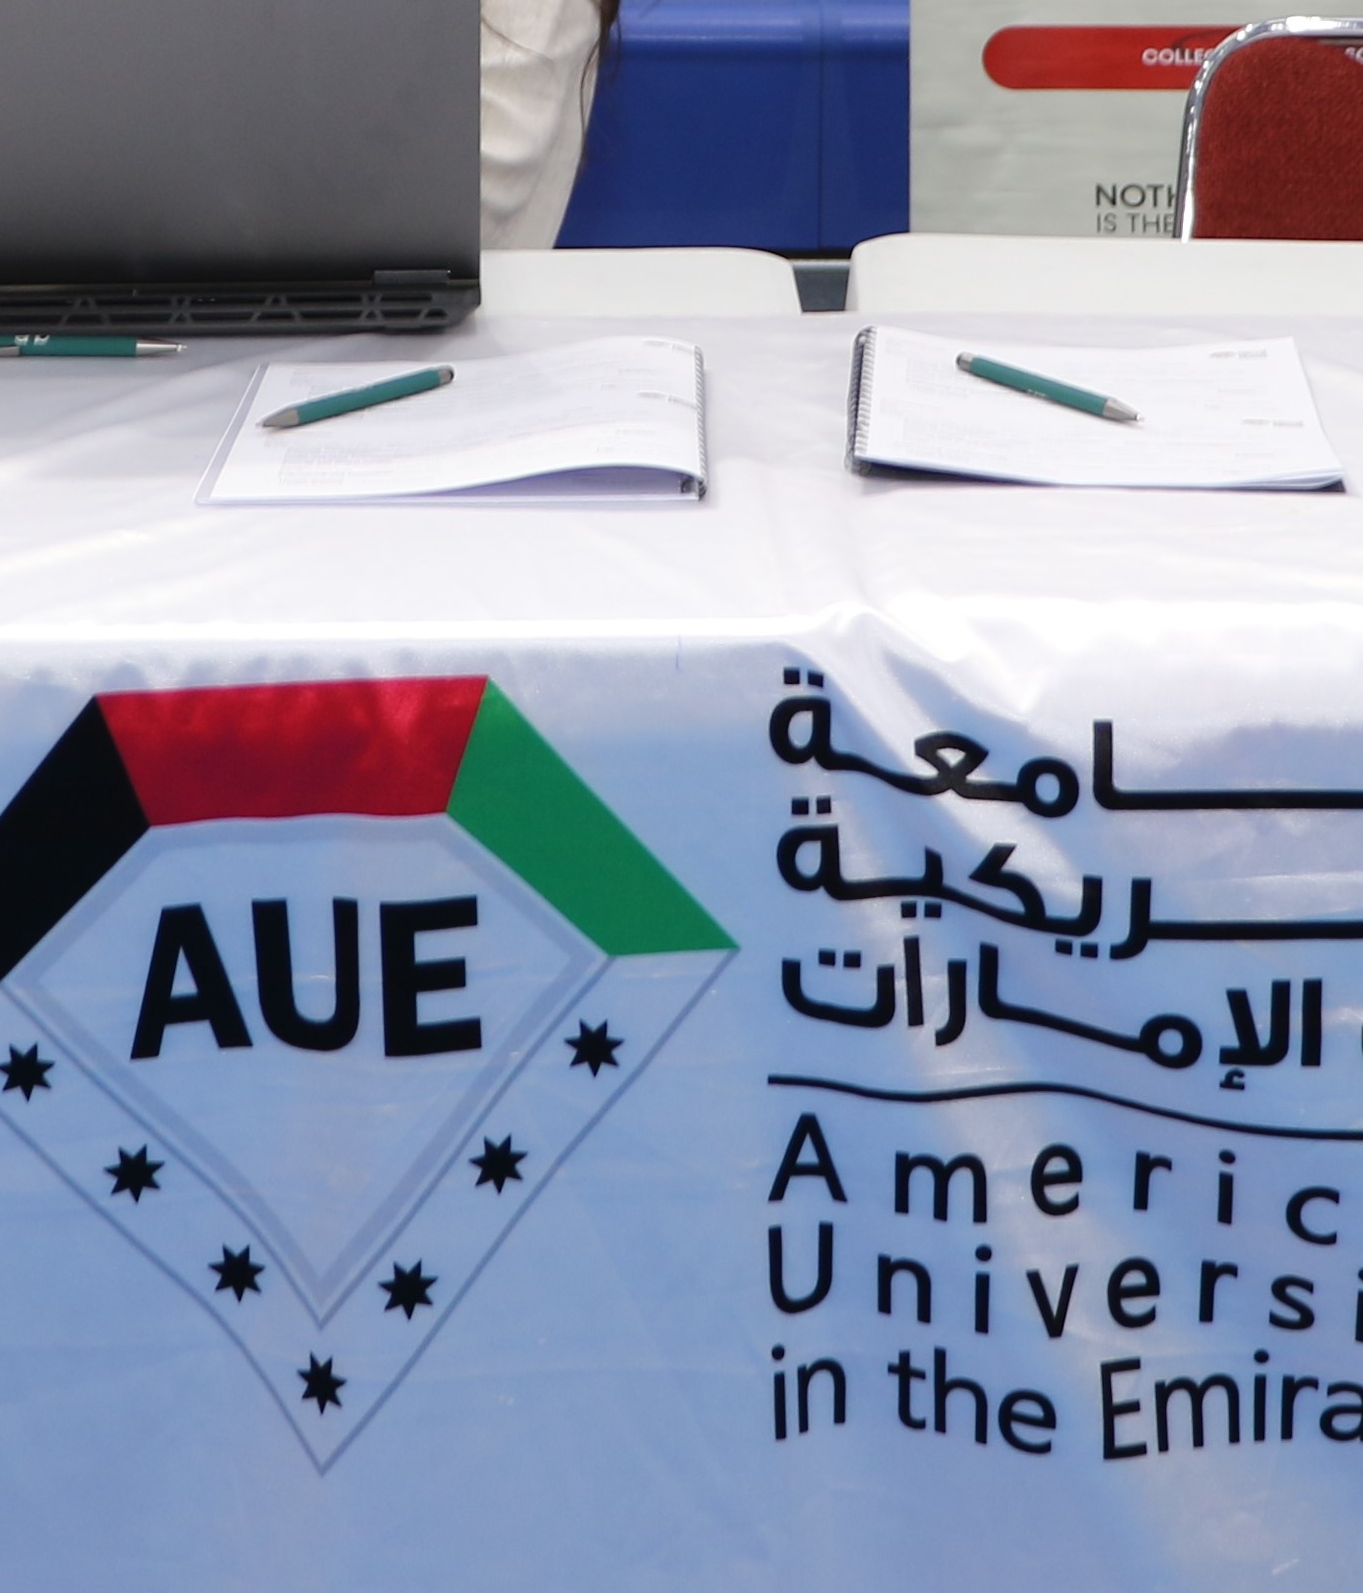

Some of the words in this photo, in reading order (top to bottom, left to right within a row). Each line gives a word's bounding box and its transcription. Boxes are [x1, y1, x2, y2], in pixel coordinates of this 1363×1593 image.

[1097, 213, 1117, 233] IS
[1127, 213, 1175, 233] THE
[130, 894, 483, 1061] AUE
[771, 1344, 848, 1441] in
[887, 1347, 1058, 1454] the
